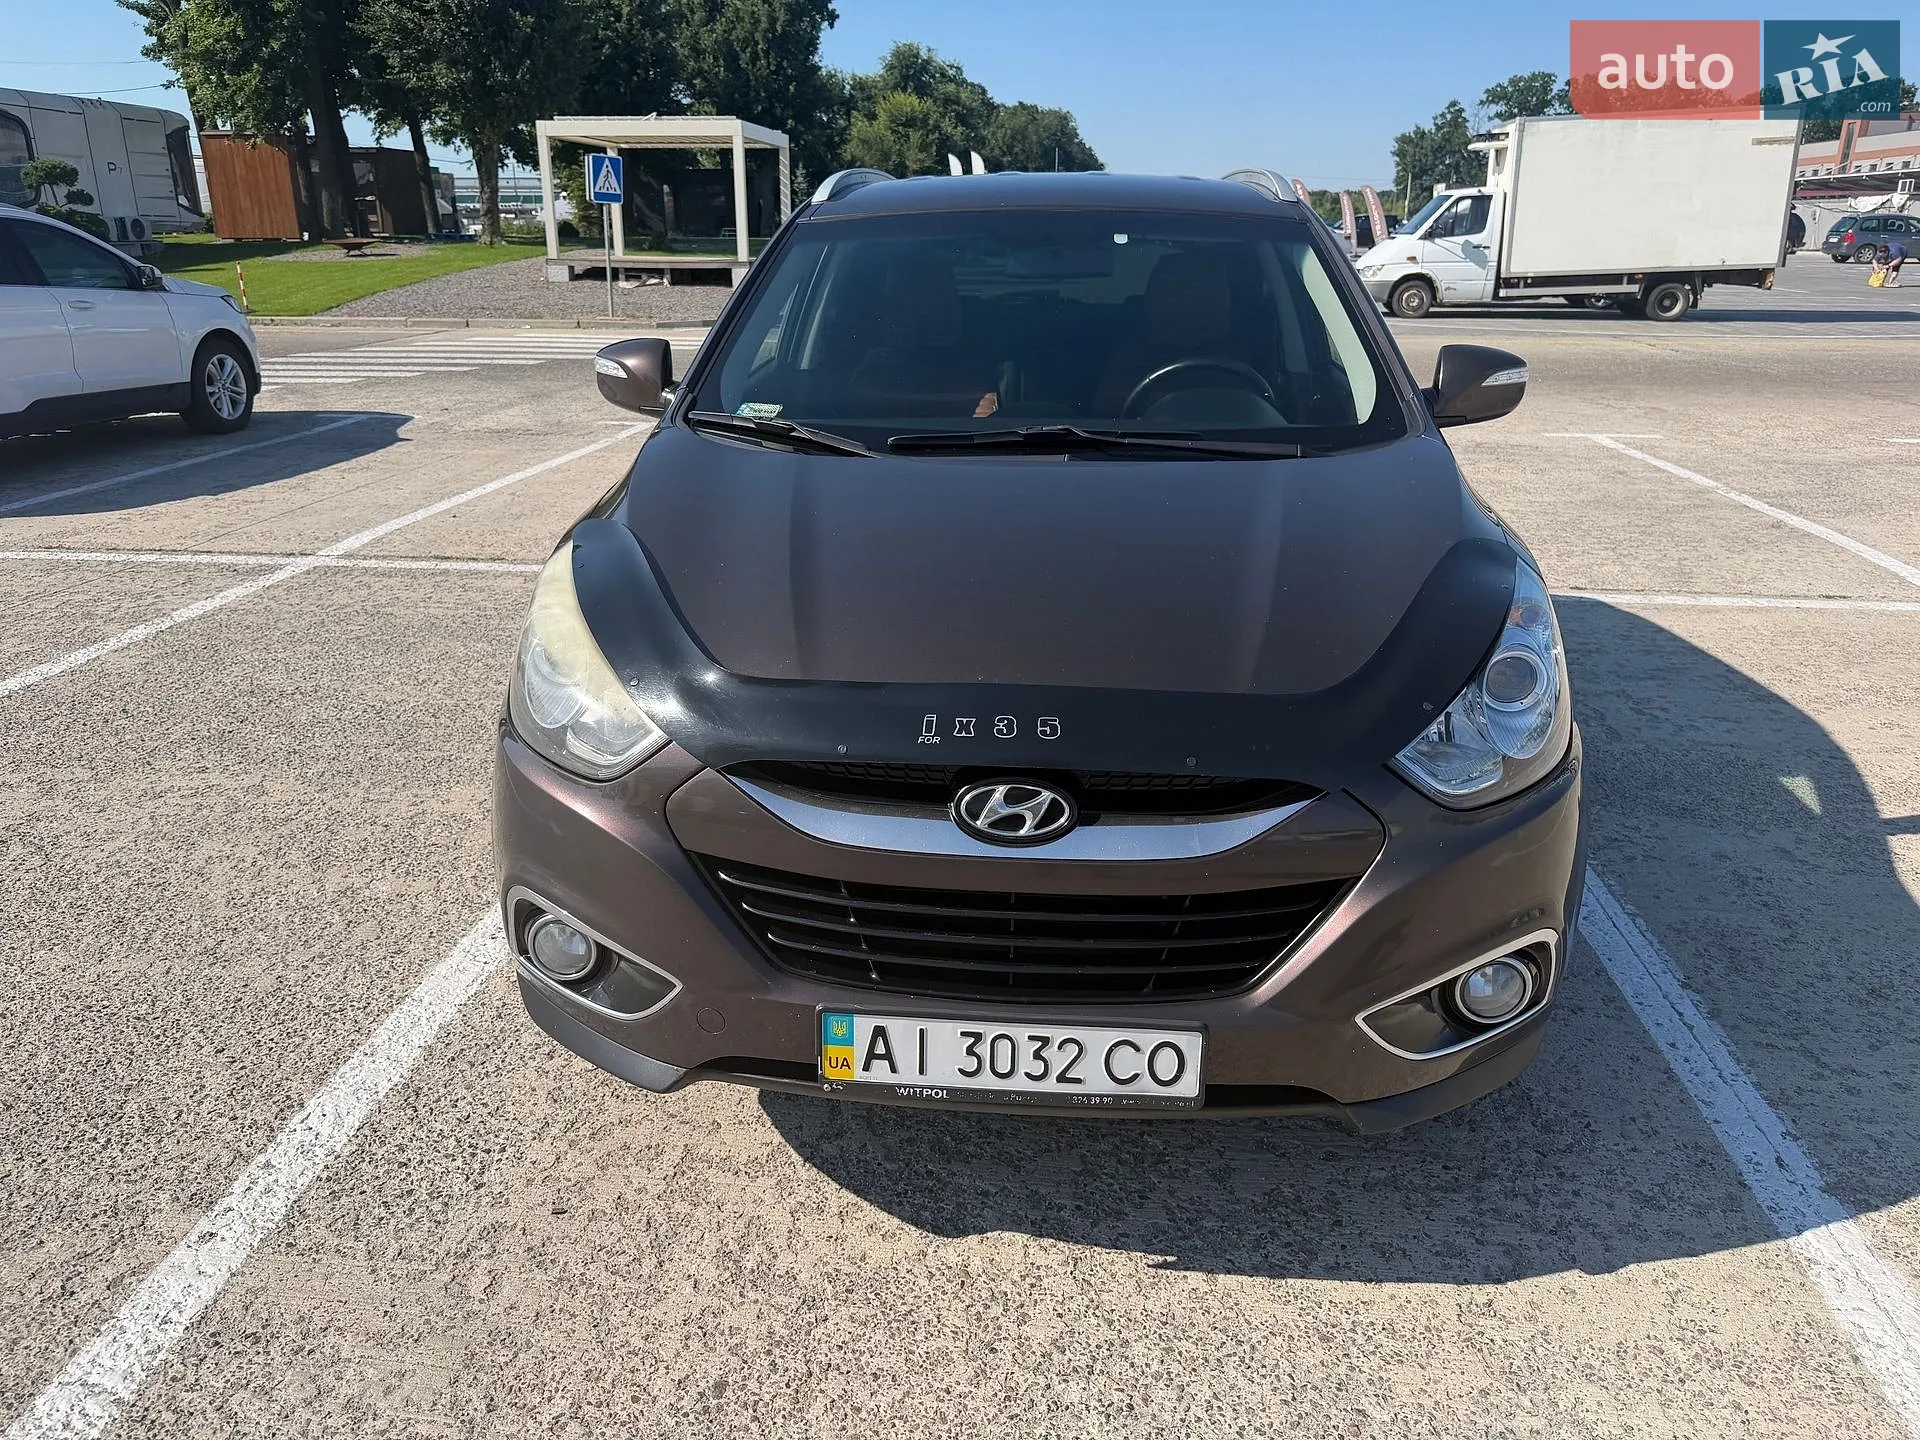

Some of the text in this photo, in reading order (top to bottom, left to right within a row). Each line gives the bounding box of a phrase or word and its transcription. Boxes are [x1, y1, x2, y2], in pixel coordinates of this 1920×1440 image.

[917, 736, 941, 744] FOR
[828, 1055, 852, 1071] UA
[861, 1024, 1186, 1087] AI 3032 CO
[895, 1086, 950, 1099] WITPOL
[1090, 1096, 1100, 1104] 39
